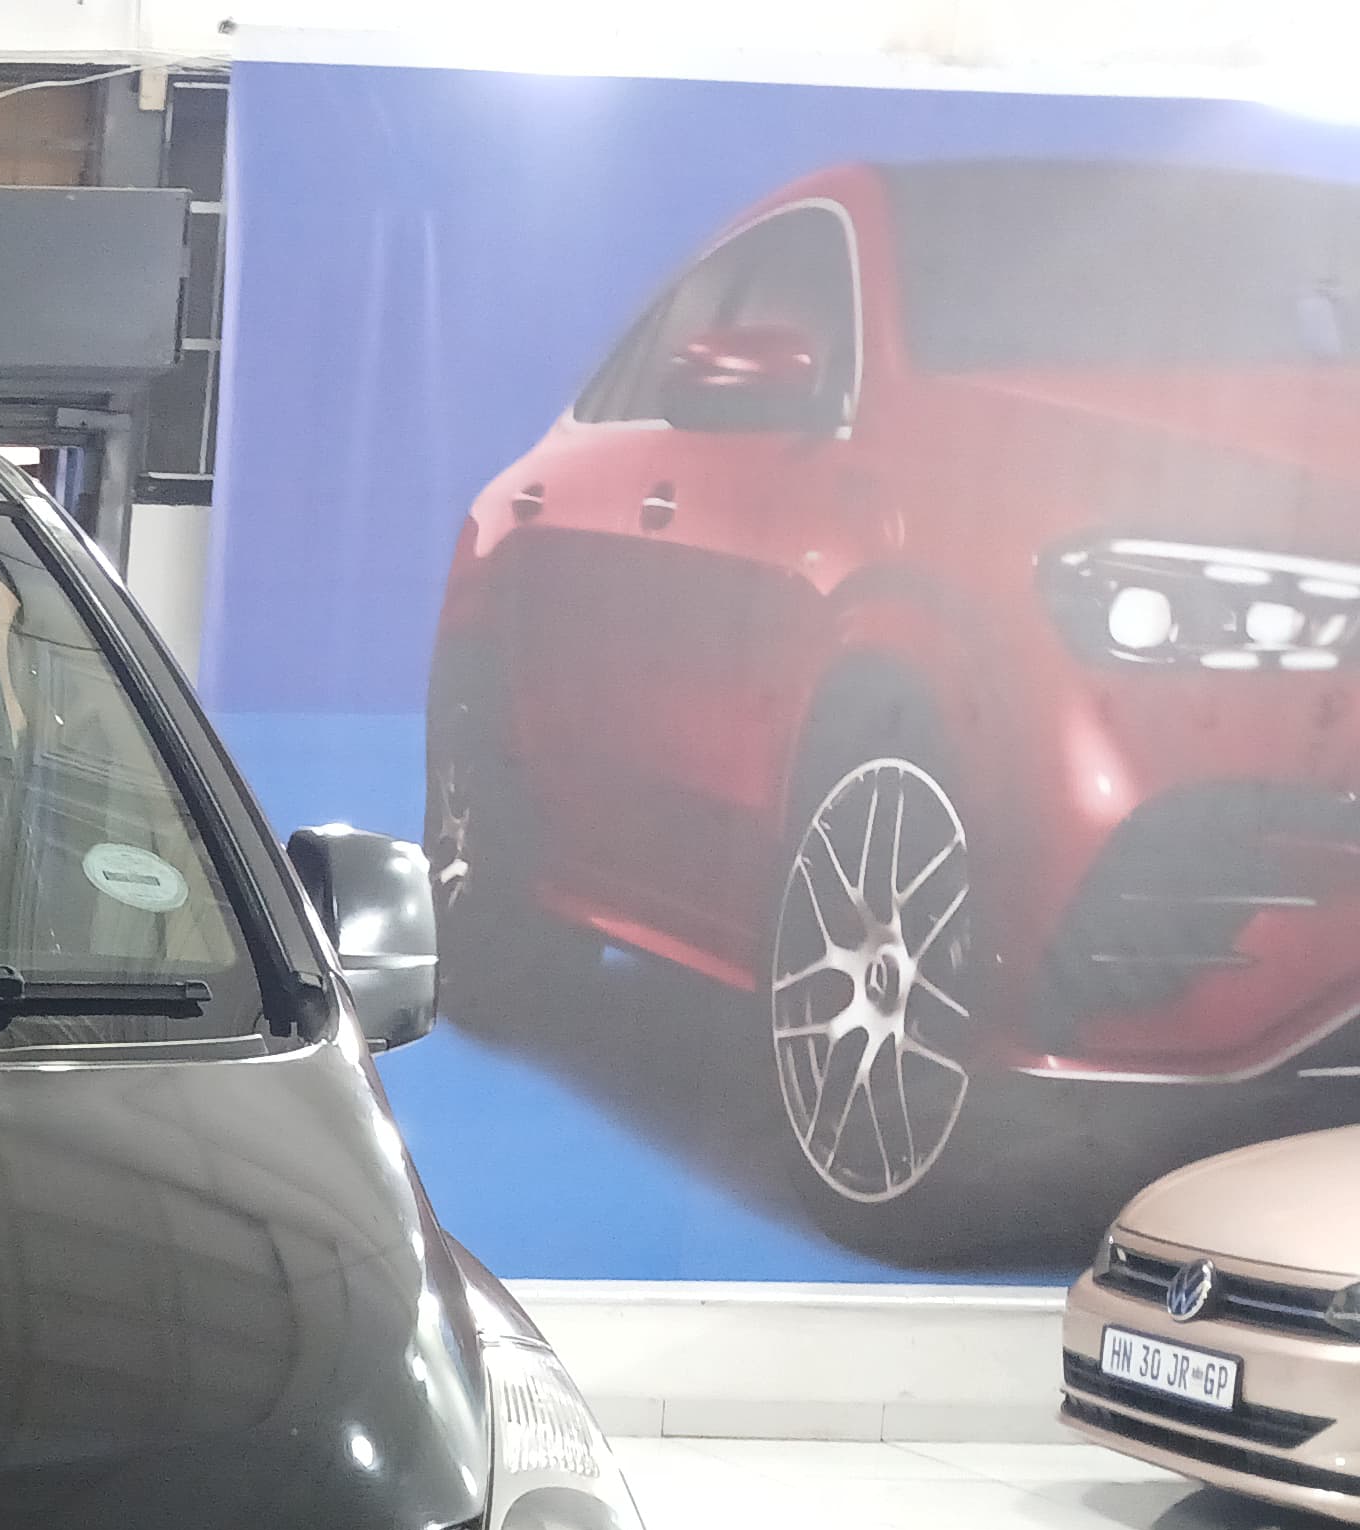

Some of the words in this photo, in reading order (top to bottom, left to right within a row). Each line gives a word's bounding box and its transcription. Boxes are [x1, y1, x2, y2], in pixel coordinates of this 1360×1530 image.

[1111, 1336, 1132, 1373] HN
[1139, 1344, 1161, 1380] 30
[1167, 1353, 1190, 1390] JR
[1204, 1363, 1228, 1400] GP
